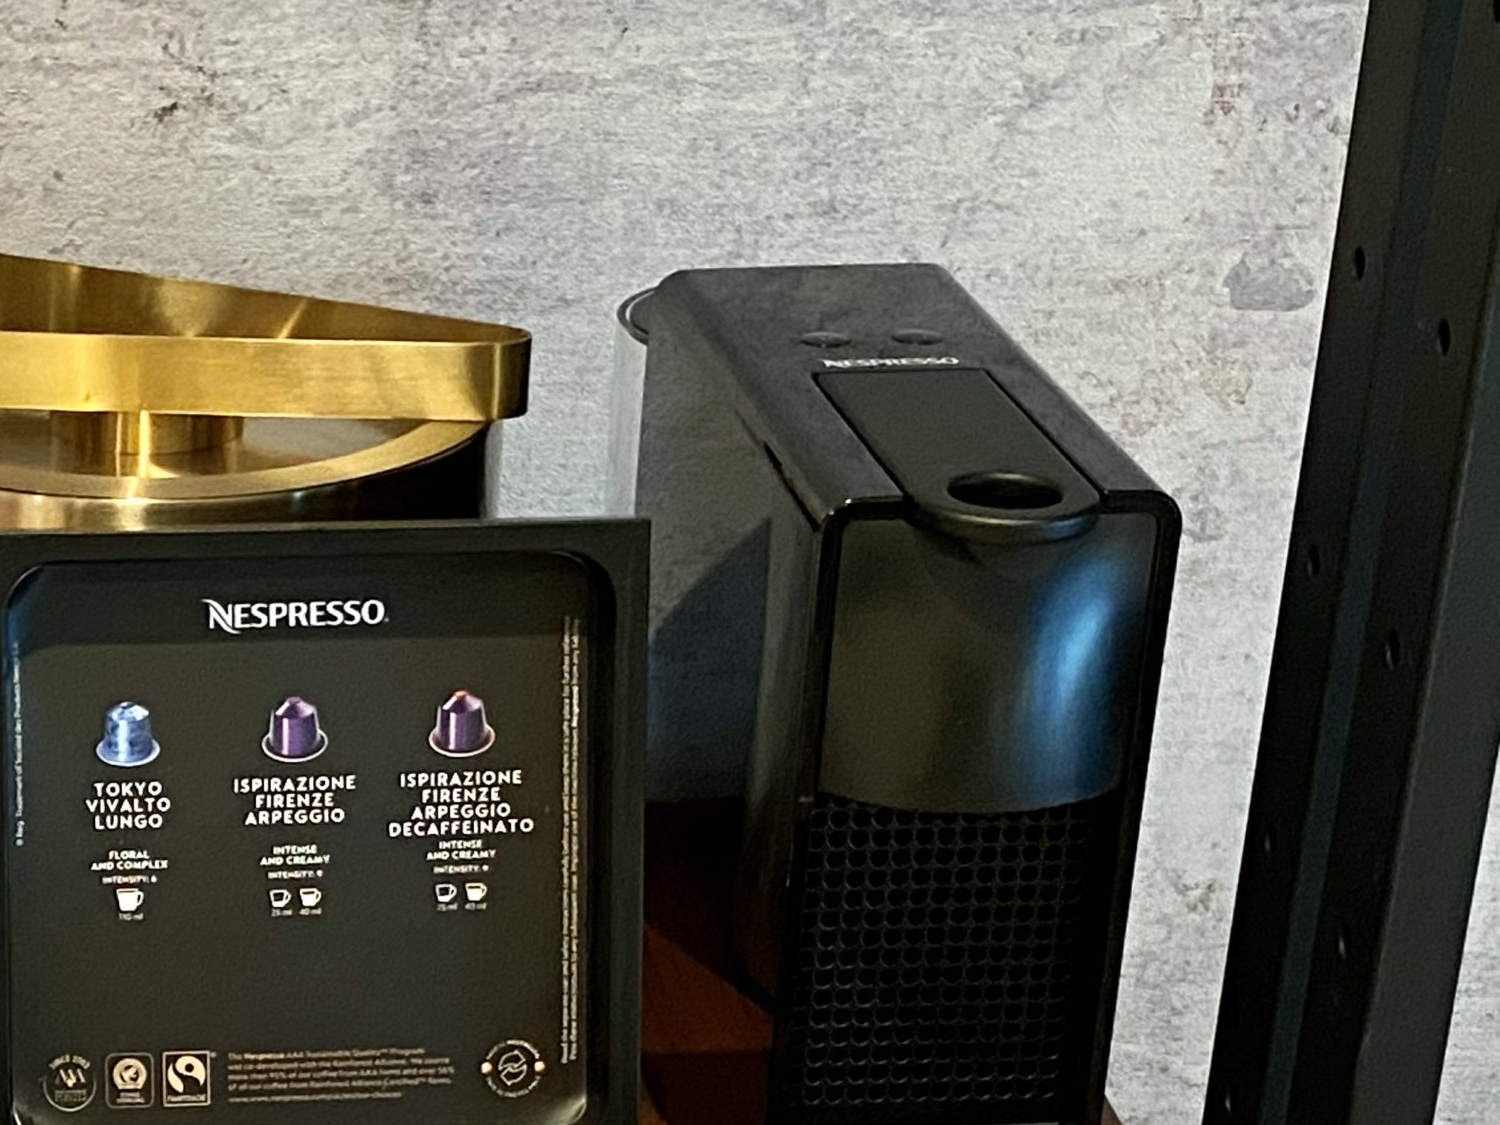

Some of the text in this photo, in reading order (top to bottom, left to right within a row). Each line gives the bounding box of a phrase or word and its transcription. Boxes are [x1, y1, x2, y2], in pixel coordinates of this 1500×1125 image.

[201, 598, 387, 634] NESPRESSO
[233, 774, 356, 793] ISPIRAZIONE
[400, 769, 522, 788] ISPIRAZIONE
[93, 781, 162, 797] TOKYO
[421, 787, 501, 803] FIRENZE
[85, 797, 171, 813] VIVALTO
[255, 792, 334, 808] FIRENZE
[244, 808, 345, 825] ARPEGGIO
[411, 802, 511, 820] ARPEGGIO
[94, 813, 163, 830] LUNGO
[388, 818, 534, 837] DECAFFEINATO
[273, 844, 317, 855] INTENSE
[439, 839, 483, 849] INTENSE
[108, 850, 150, 860] FLORAL
[260, 854, 330, 865] AND CREAMY
[426, 849, 496, 860] AND CREAMY
[91, 860, 169, 870] AND COMPLEX
